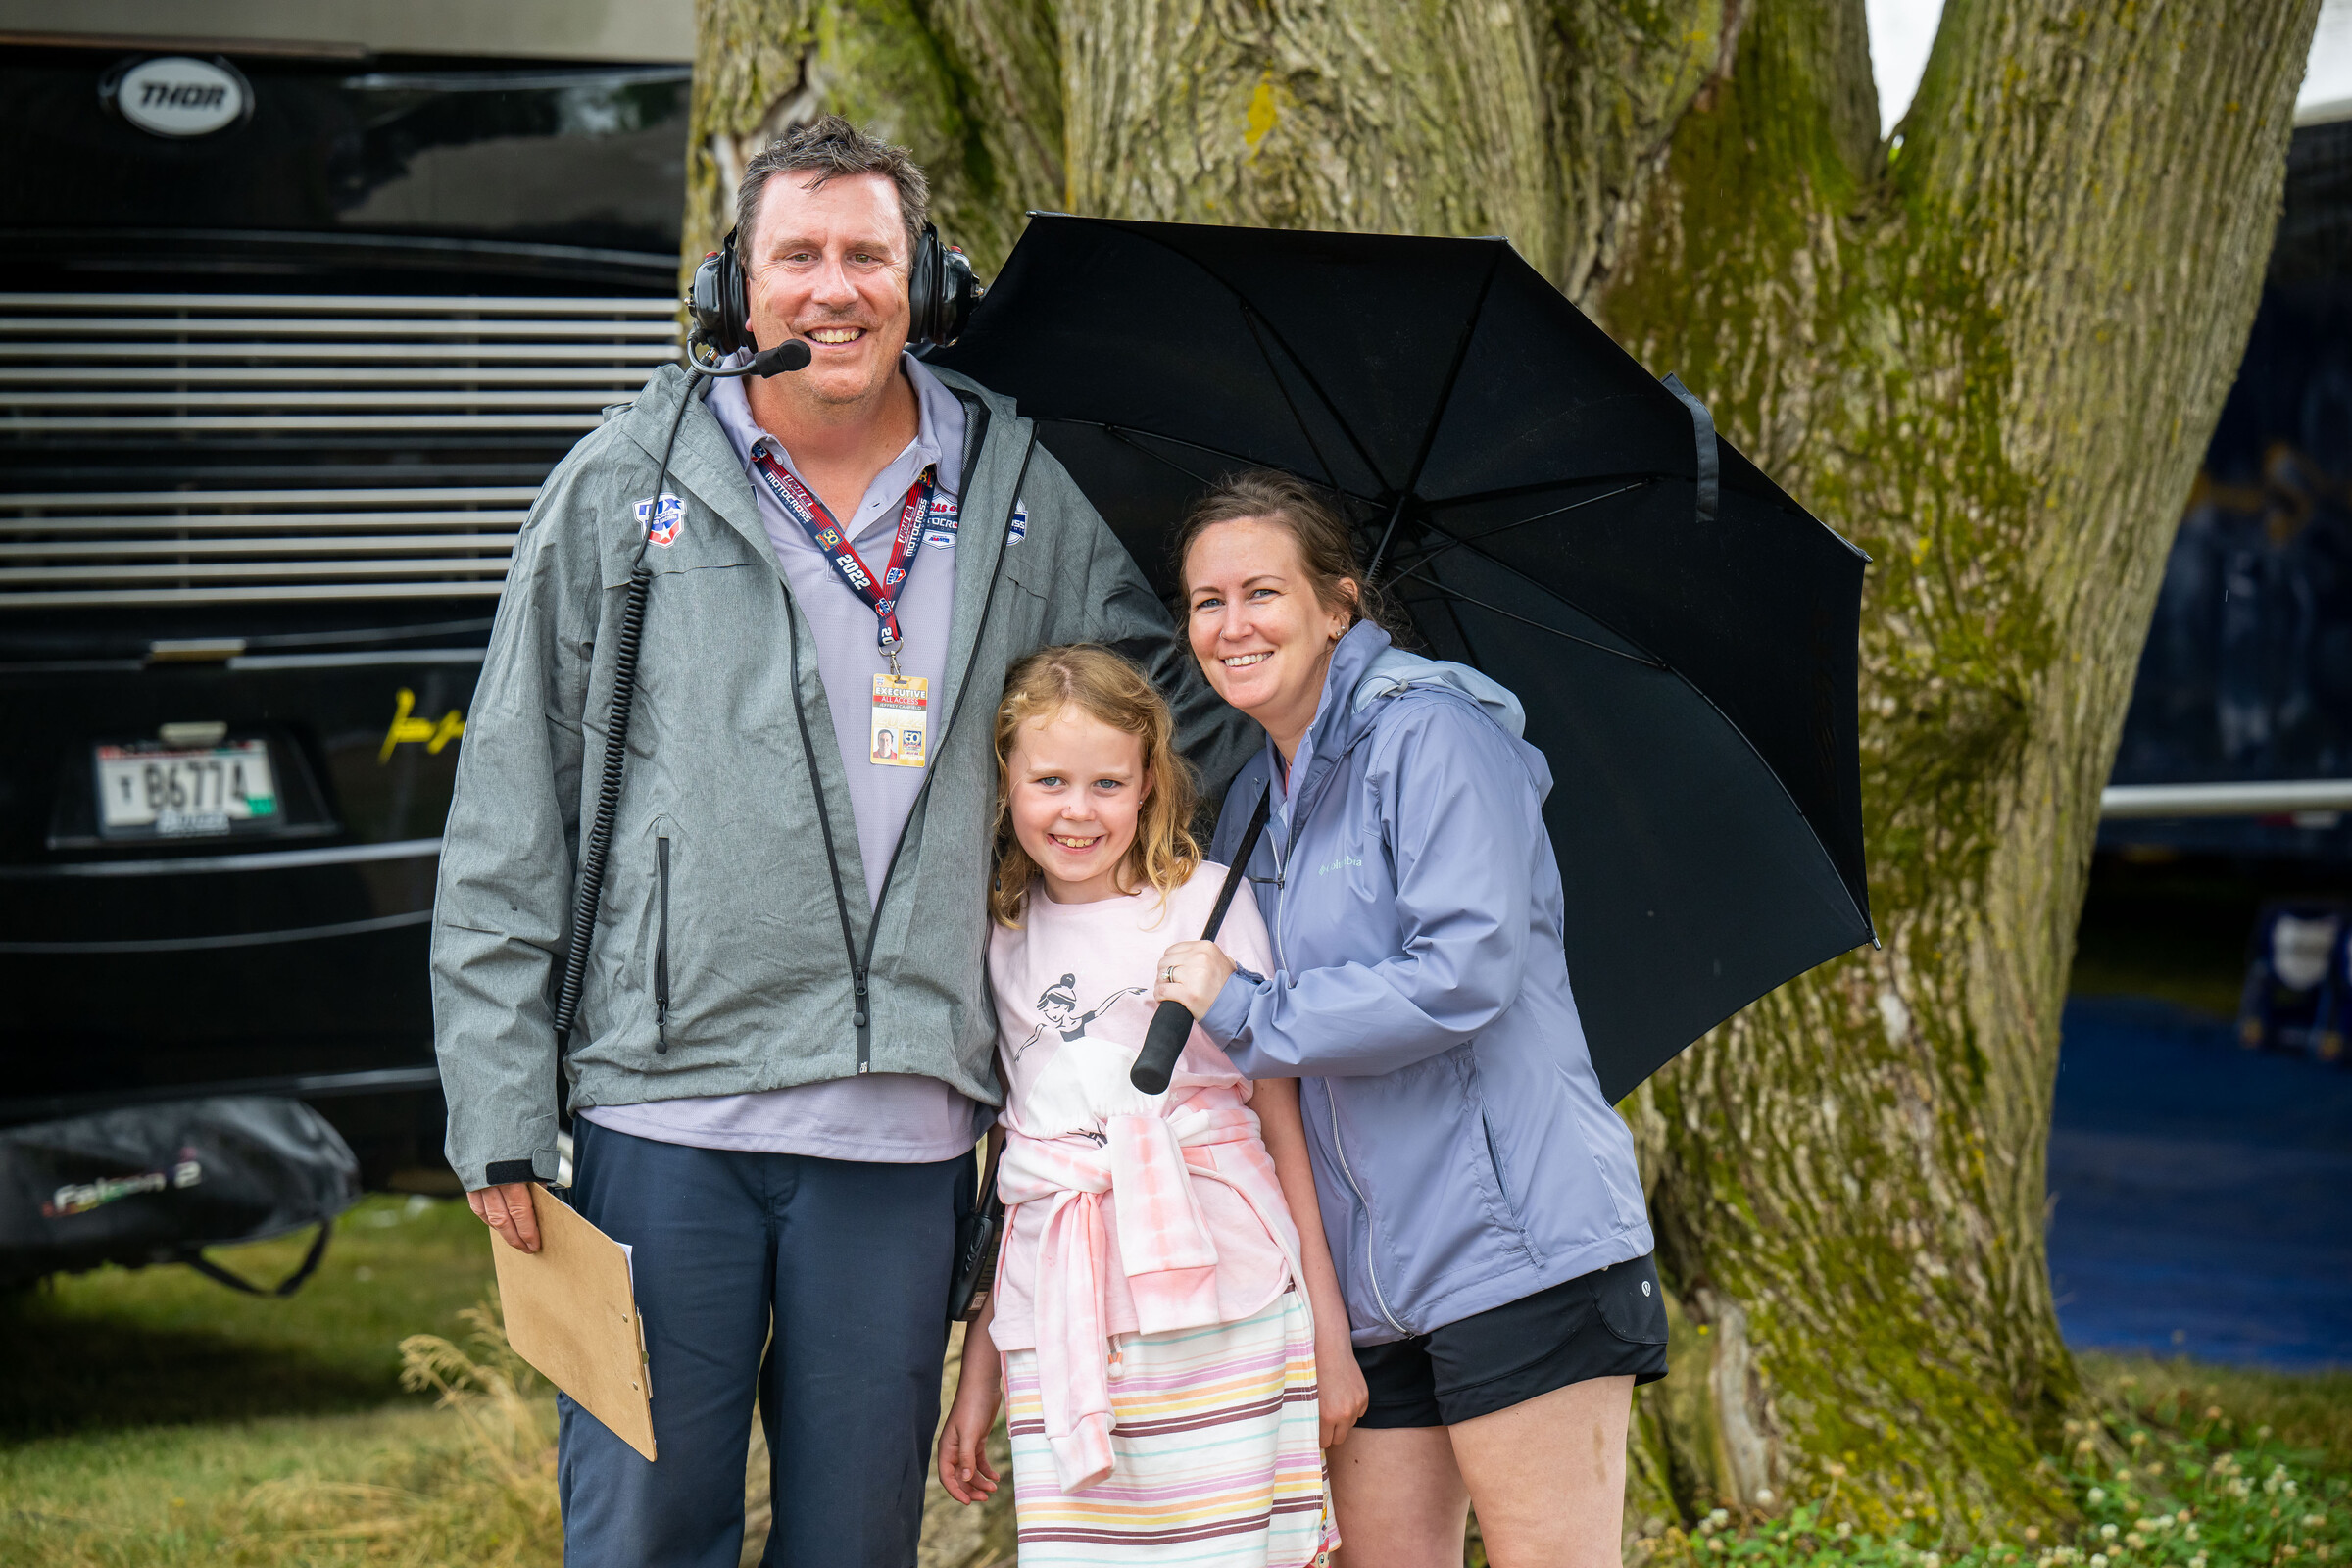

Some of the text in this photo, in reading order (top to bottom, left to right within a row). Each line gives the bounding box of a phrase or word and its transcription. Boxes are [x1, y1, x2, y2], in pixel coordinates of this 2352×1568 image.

[140, 80, 226, 110] THOR
[765, 471, 812, 523] MOTOCROSS
[784, 475, 804, 496] LUCAS
[800, 494, 813, 507] OIL
[824, 530, 839, 545] 50
[898, 506, 914, 542] LUCAS OIL
[906, 498, 928, 557] MOTOCROSS
[836, 554, 871, 591] 2022
[875, 687, 926, 699] EXECUTIVE
[906, 732, 919, 742] 50
